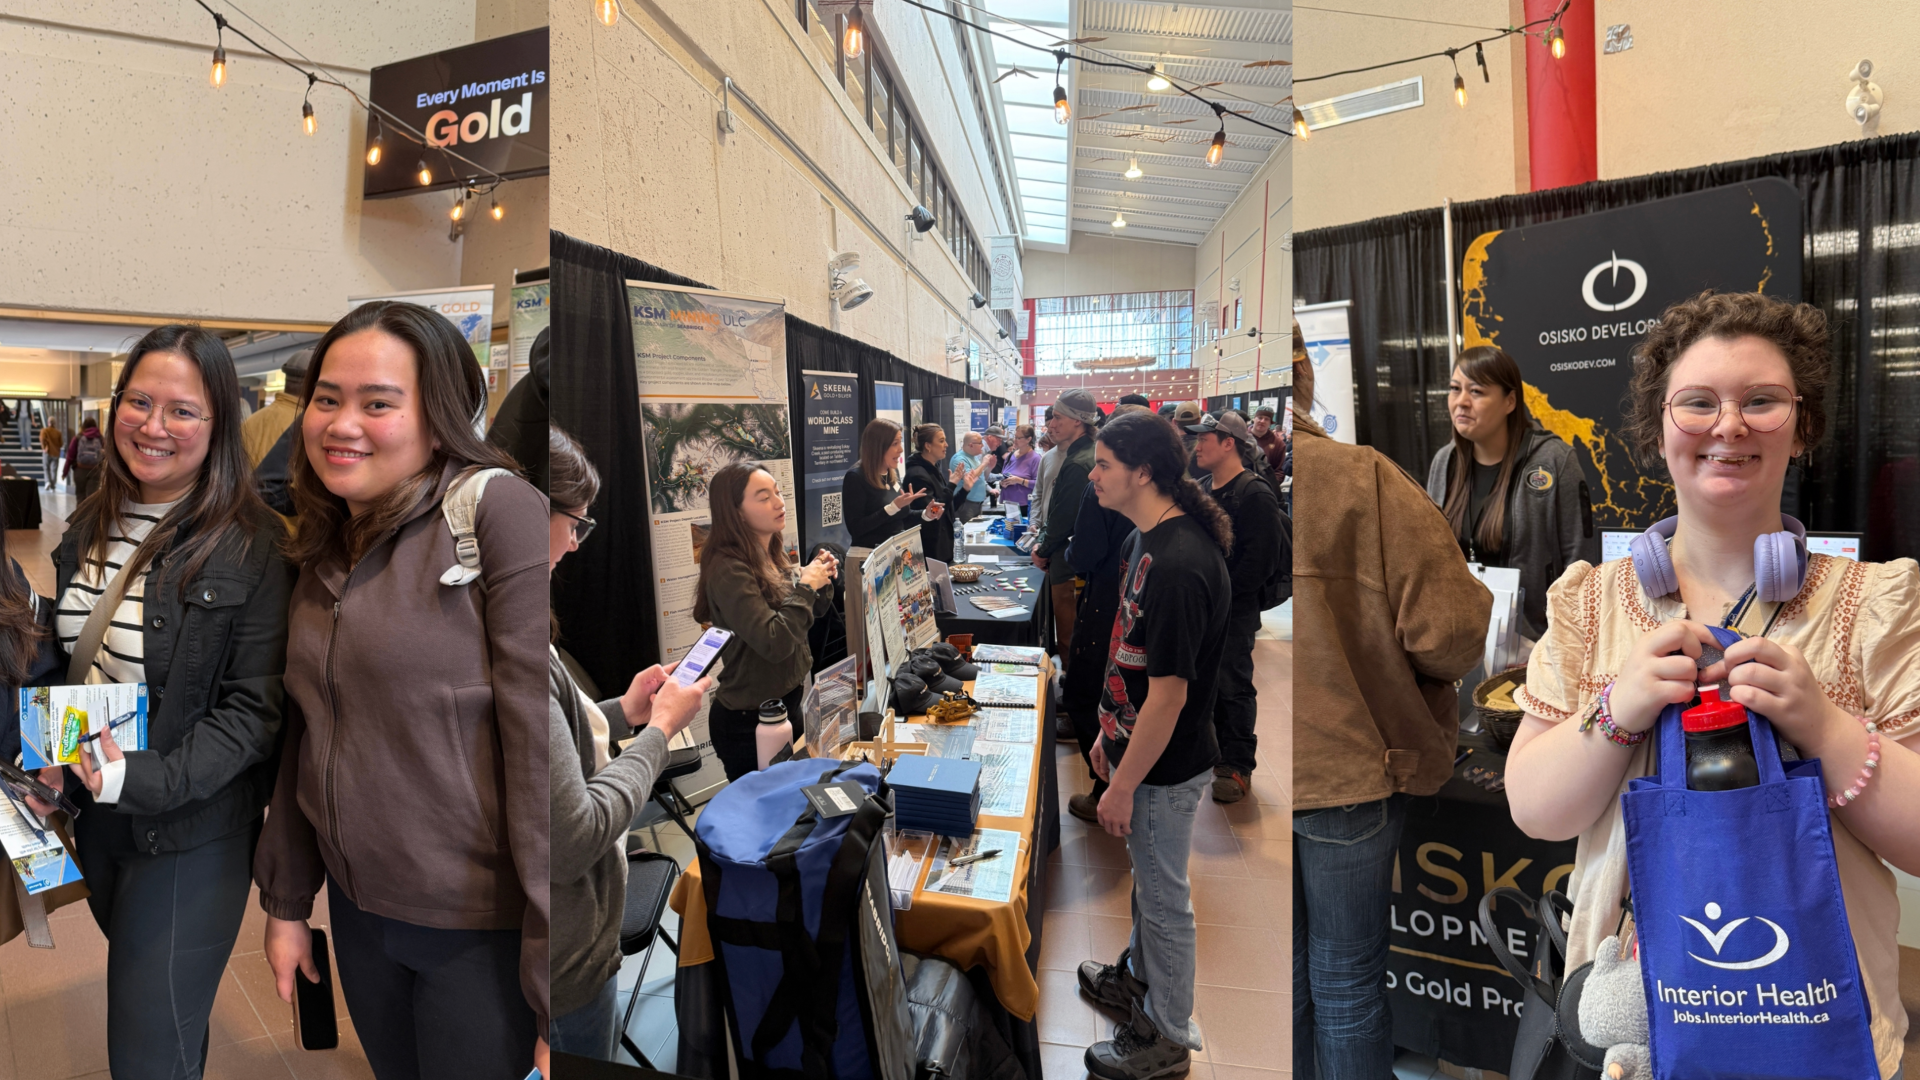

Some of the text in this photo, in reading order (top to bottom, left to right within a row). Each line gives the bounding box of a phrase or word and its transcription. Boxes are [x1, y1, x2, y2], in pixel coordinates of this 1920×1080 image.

[416, 69, 546, 108] Every Moment Is
[425, 91, 533, 148] Gold
[441, 301, 481, 314] GOLD
[516, 297, 542, 309] KSM
[633, 305, 747, 328] KSM MINING ULC
[1539, 327, 1587, 346] OSISKO
[1550, 358, 1616, 372] OSISKODEV.COM
[823, 383, 852, 393] SKEENA
[807, 416, 854, 425] WORLD-CLASS
[823, 426, 840, 434] MINE
[1117, 650, 1147, 664] EADPOOL
[61, 713, 76, 757] Fruitsations
[1390, 904, 1540, 957] LOPME
[1405, 971, 1471, 1008] Gold
[1657, 977, 1838, 1007] Interior Health
[1673, 1009, 1830, 1024] Jobs.InteriorHealth.ca
